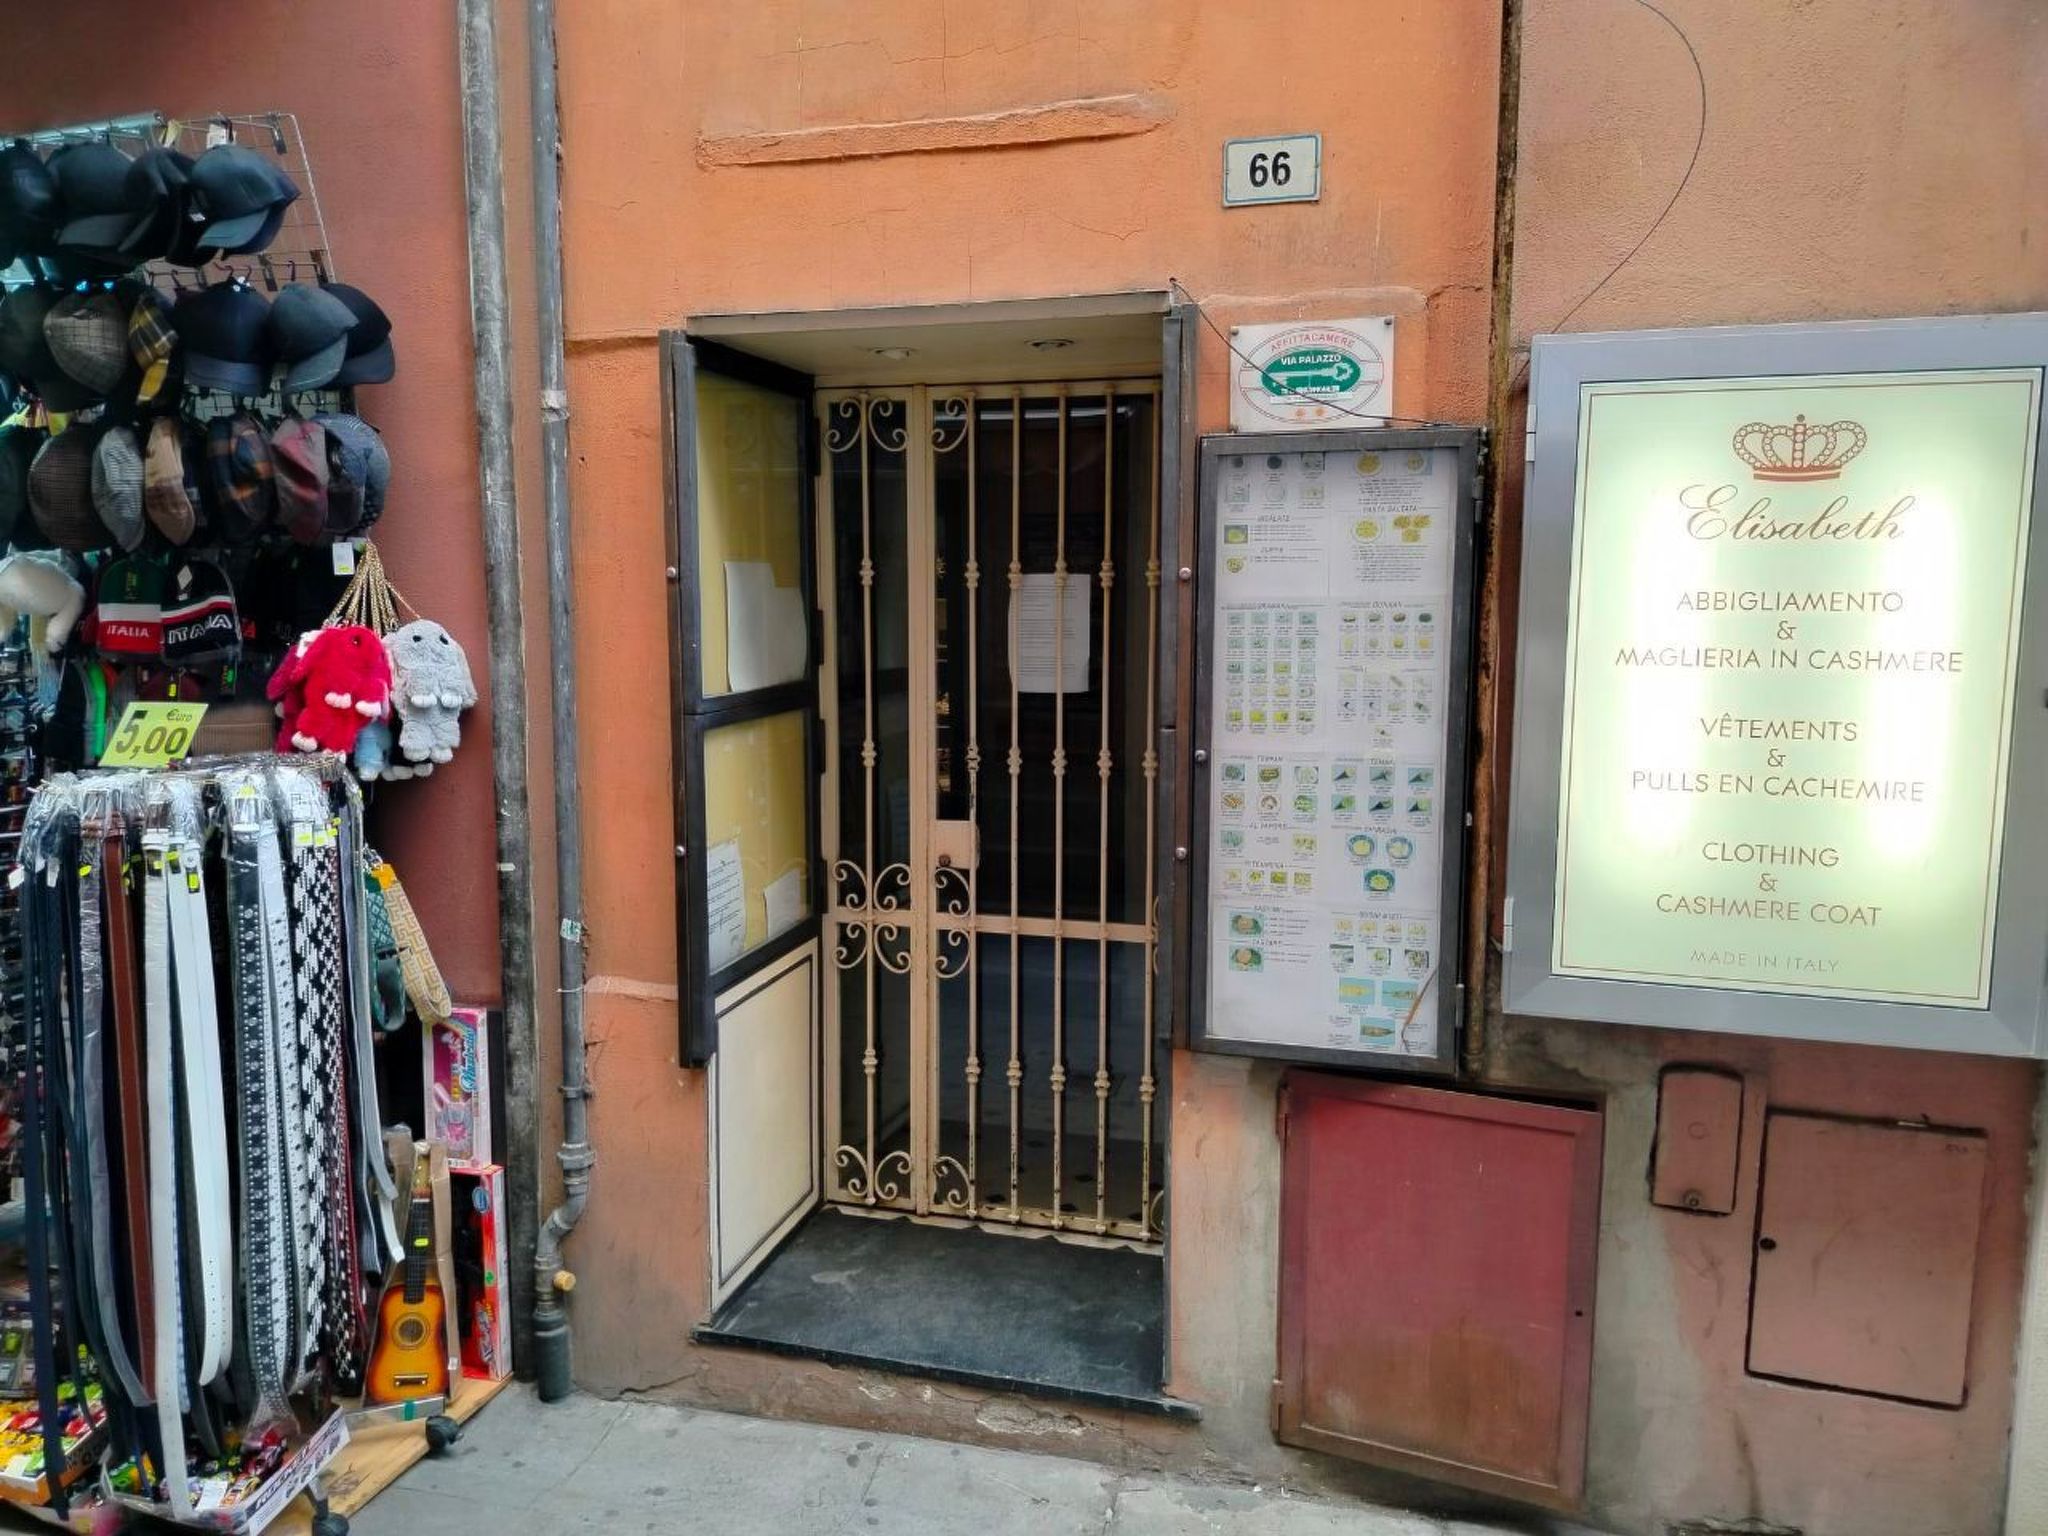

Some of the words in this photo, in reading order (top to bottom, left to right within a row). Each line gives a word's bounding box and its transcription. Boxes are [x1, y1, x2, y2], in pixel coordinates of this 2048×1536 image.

[1249, 151, 1291, 188] 66
[1281, 357, 1297, 366] VIA
[1299, 354, 1342, 365] PALAZZO
[1679, 484, 1920, 540] Elisabeth
[1676, 591, 1904, 613] ABBIGLIAMENTO
[107, 625, 150, 637] ITALIA
[168, 614, 232, 643] ITAA
[1776, 620, 1797, 641] &
[1615, 647, 1761, 669] MAGLIERIA
[1771, 649, 1798, 669] IN
[1808, 650, 1963, 673] CASHMERE
[114, 709, 189, 760] 5,00
[1700, 713, 1858, 742] VÊTEMENTS
[1767, 748, 1786, 768] &
[1633, 770, 1709, 793] PULLS
[1719, 774, 1753, 794] EN
[1763, 777, 1925, 802] CACHEMIRE
[1702, 842, 1840, 868] CLOTHING
[1759, 873, 1778, 892] &
[1656, 893, 1800, 922] CASHMERE
[1810, 903, 1882, 926] COAT
[1690, 949, 1747, 967] MADE
[1757, 954, 1777, 968] IN
[1786, 956, 1840, 973] ITALY
